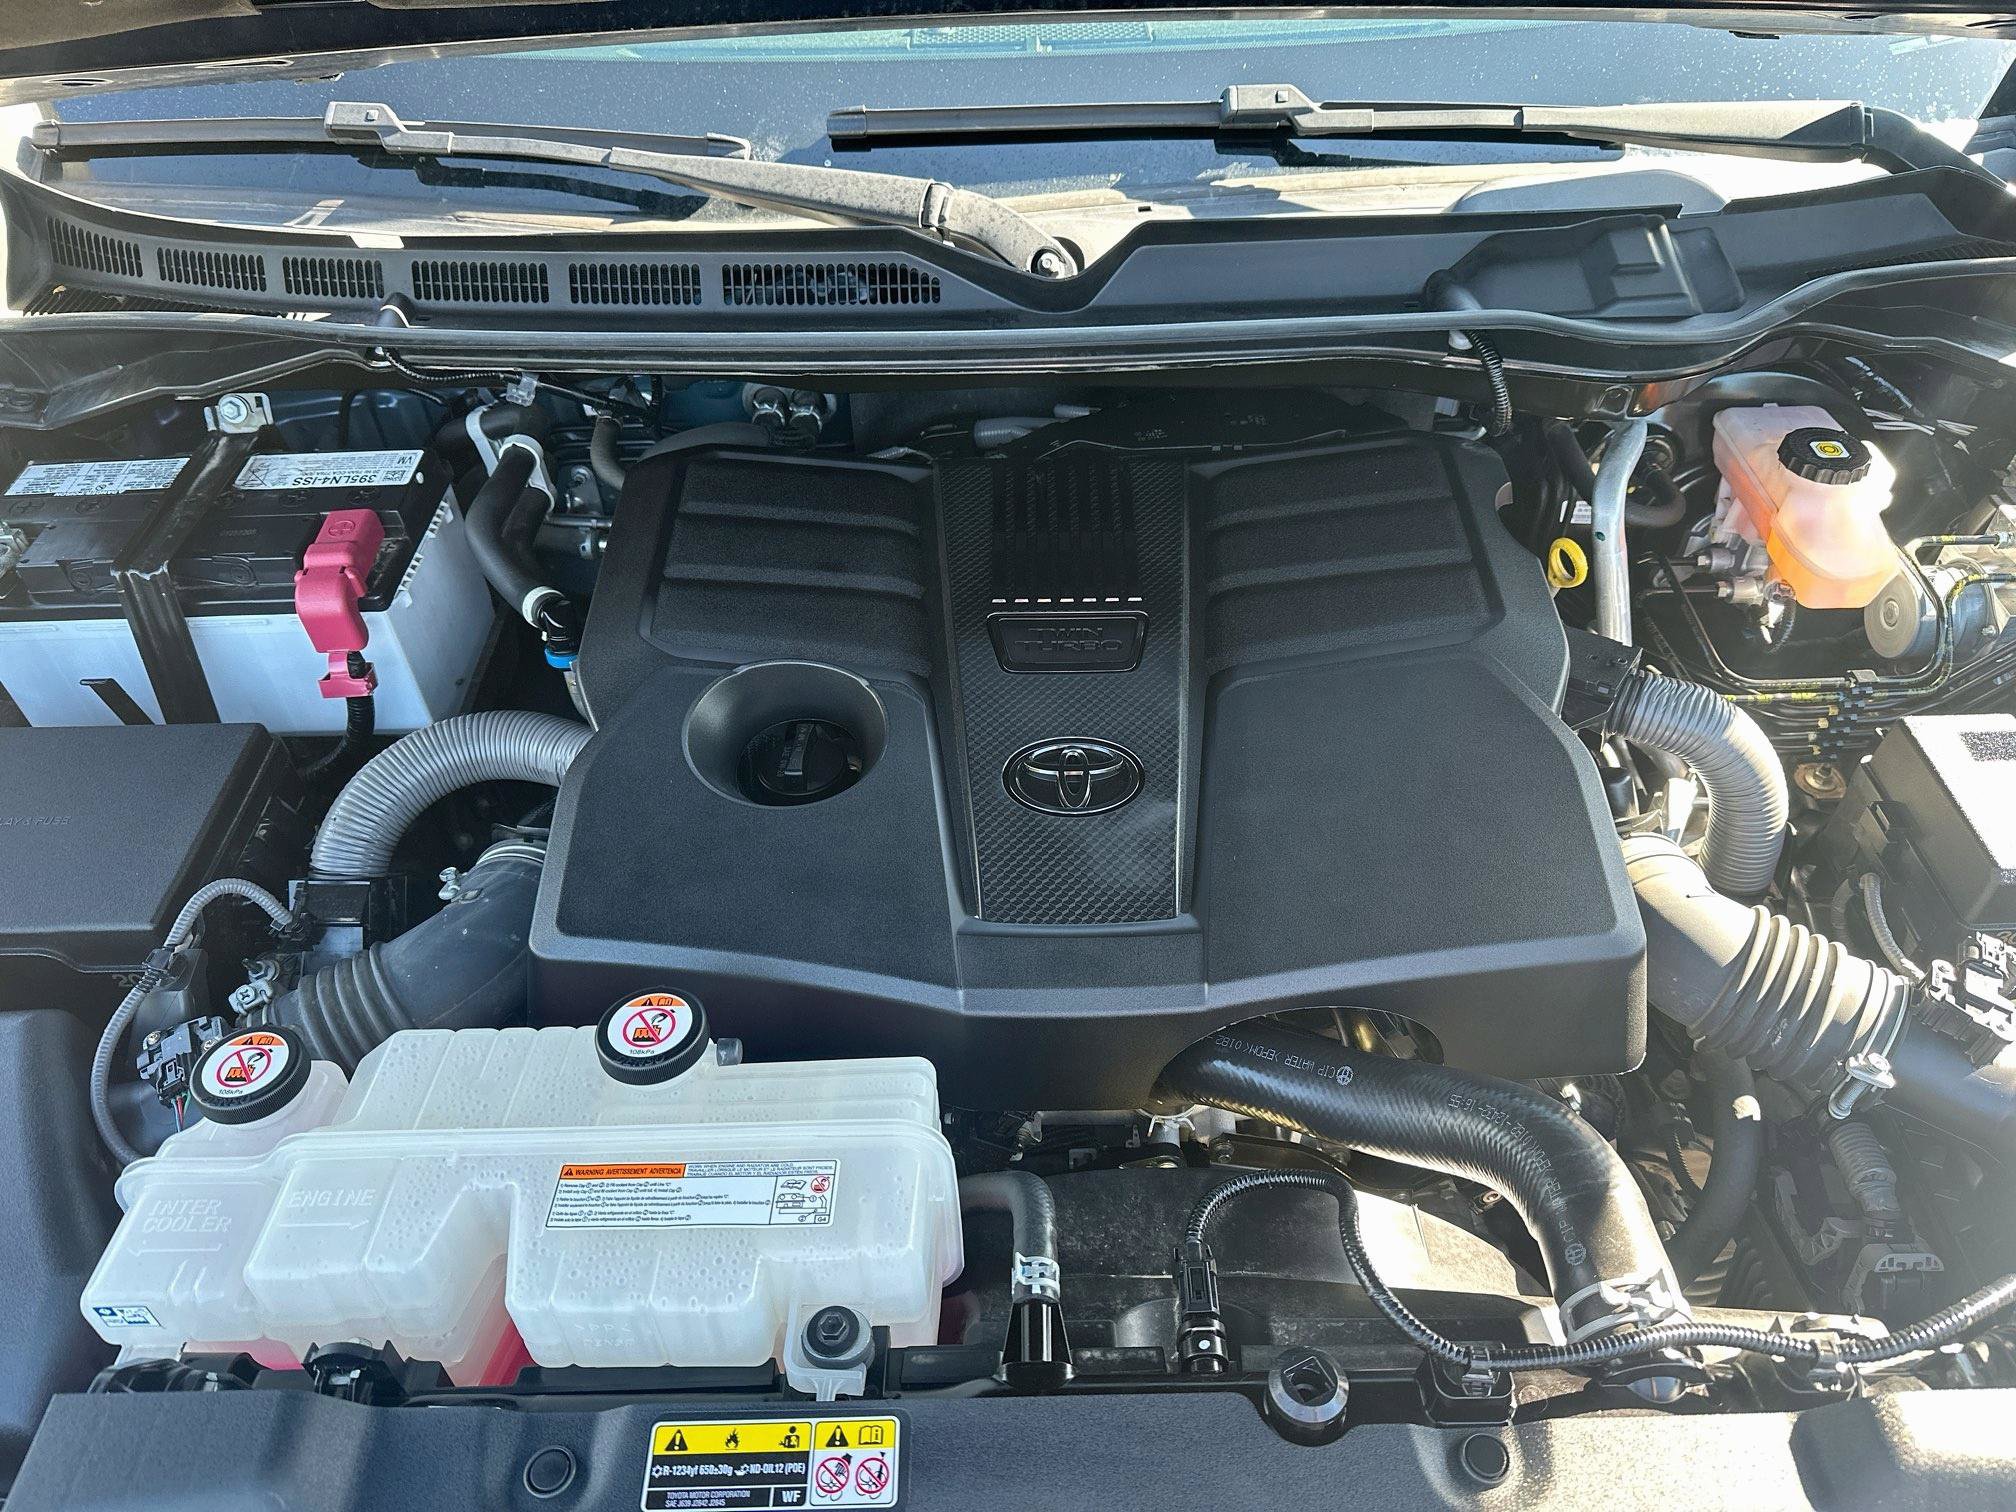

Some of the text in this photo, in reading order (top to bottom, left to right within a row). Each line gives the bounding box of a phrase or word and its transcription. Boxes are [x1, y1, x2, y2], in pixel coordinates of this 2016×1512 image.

[292, 474, 377, 486] 395LN4-ISS
[1014, 640, 1123, 652] TURBO
[1284, 1053, 1315, 1071] WATER
[1317, 1064, 1336, 1079] CIP
[575, 1167, 604, 1176] WARNING
[605, 1167, 648, 1176] AVERTISSEMENT
[286, 1188, 376, 1208] ENGINE
[148, 1199, 222, 1216] INTER
[143, 1215, 233, 1233] COOLER
[663, 1464, 699, 1477] R-1234yf
[784, 1462, 806, 1476] (POE)
[666, 1491, 689, 1499] TOYOTA
[710, 1490, 751, 1498] CORPORATION
[782, 1490, 801, 1502] WF
